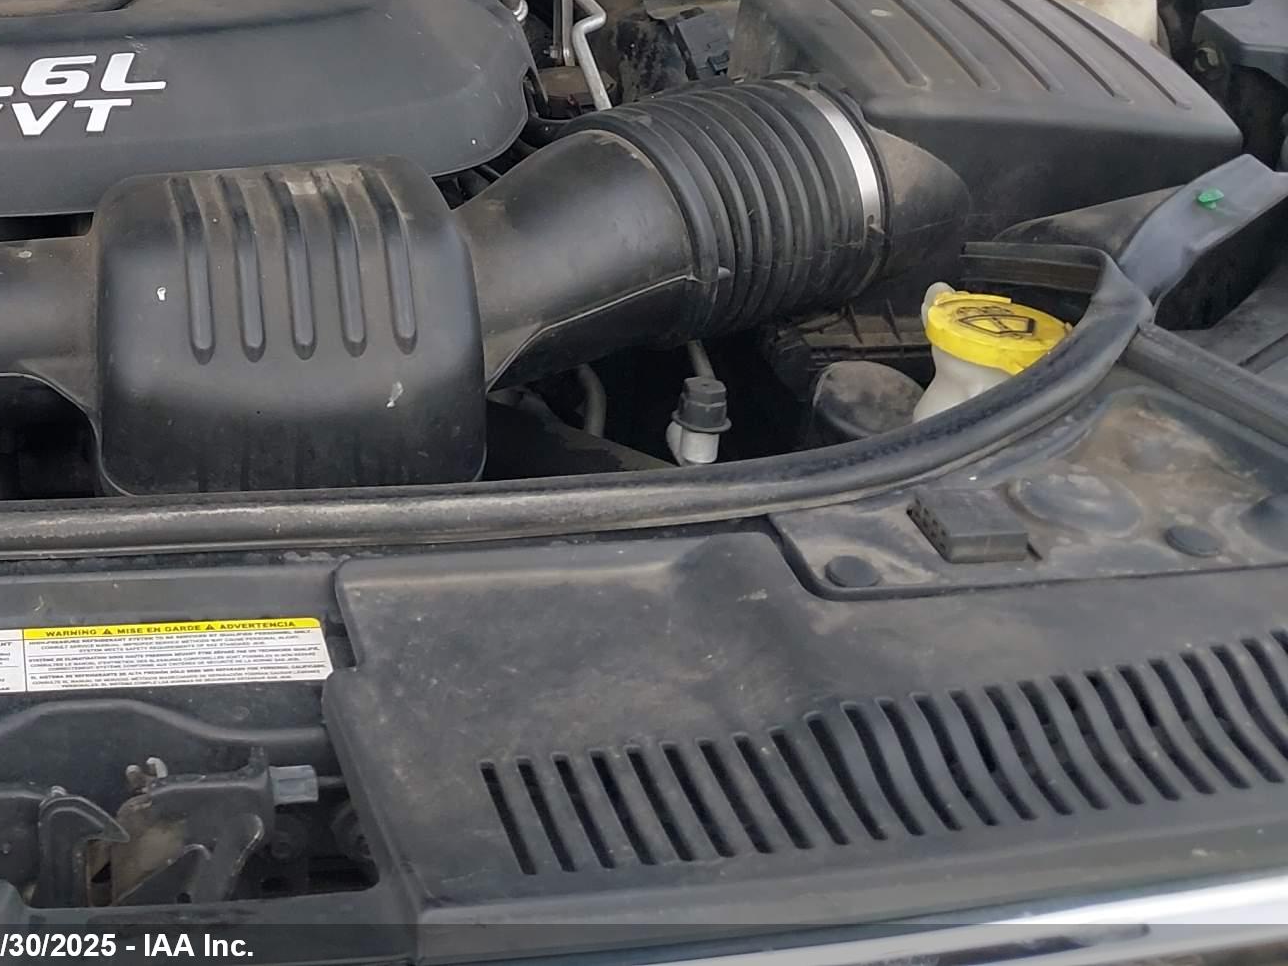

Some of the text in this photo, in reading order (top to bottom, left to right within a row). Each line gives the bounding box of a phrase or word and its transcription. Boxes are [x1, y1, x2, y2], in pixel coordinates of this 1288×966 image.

[45, 628, 97, 637] WARNING
[165, 624, 201, 632] GARDE
[220, 621, 296, 630] ADVERTENCIA
